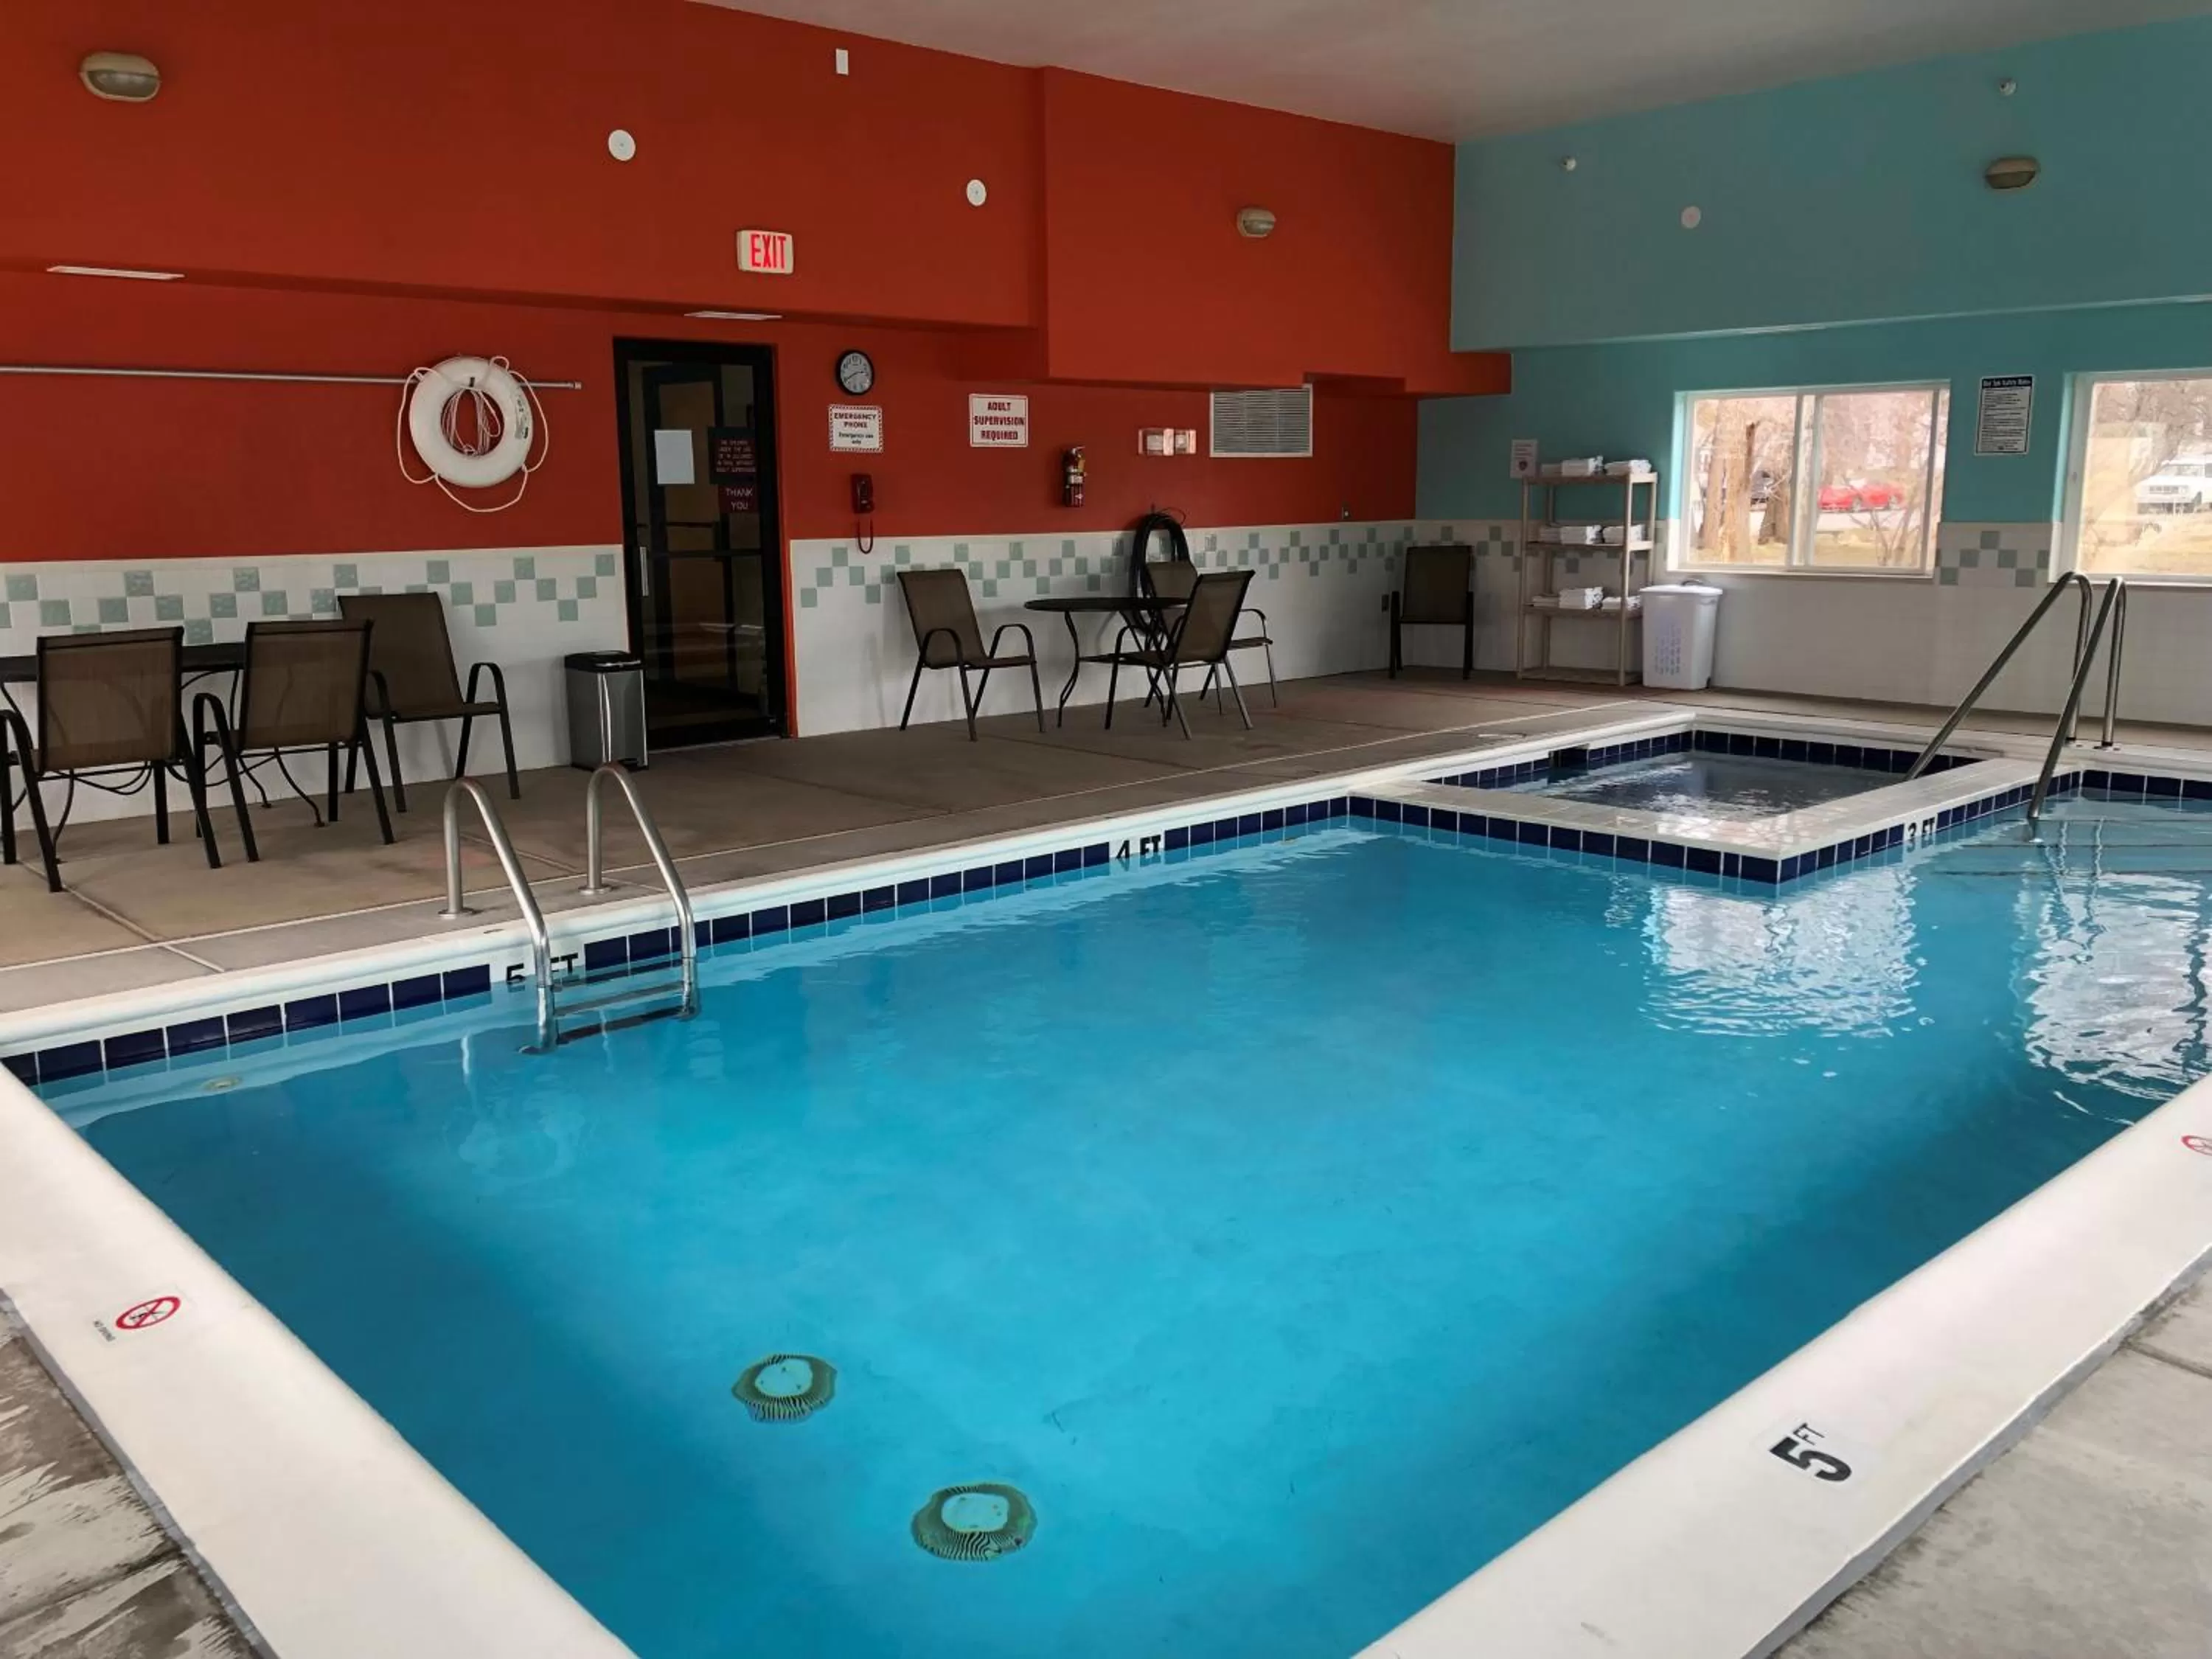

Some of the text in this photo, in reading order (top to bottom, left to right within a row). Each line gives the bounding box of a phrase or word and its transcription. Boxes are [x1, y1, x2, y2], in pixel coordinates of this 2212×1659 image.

[751, 234, 787, 269] EXIT
[987, 401, 1012, 411] ADULT
[974, 415, 1025, 425] SUPERVISION
[981, 430, 1018, 441] REQUIRED
[725, 487, 753, 497] THANK
[731, 501, 749, 511] YOU
[1116, 834, 1161, 859] 4 FT
[507, 962, 526, 986] 5
[1770, 1422, 1852, 1482] 5 FT
